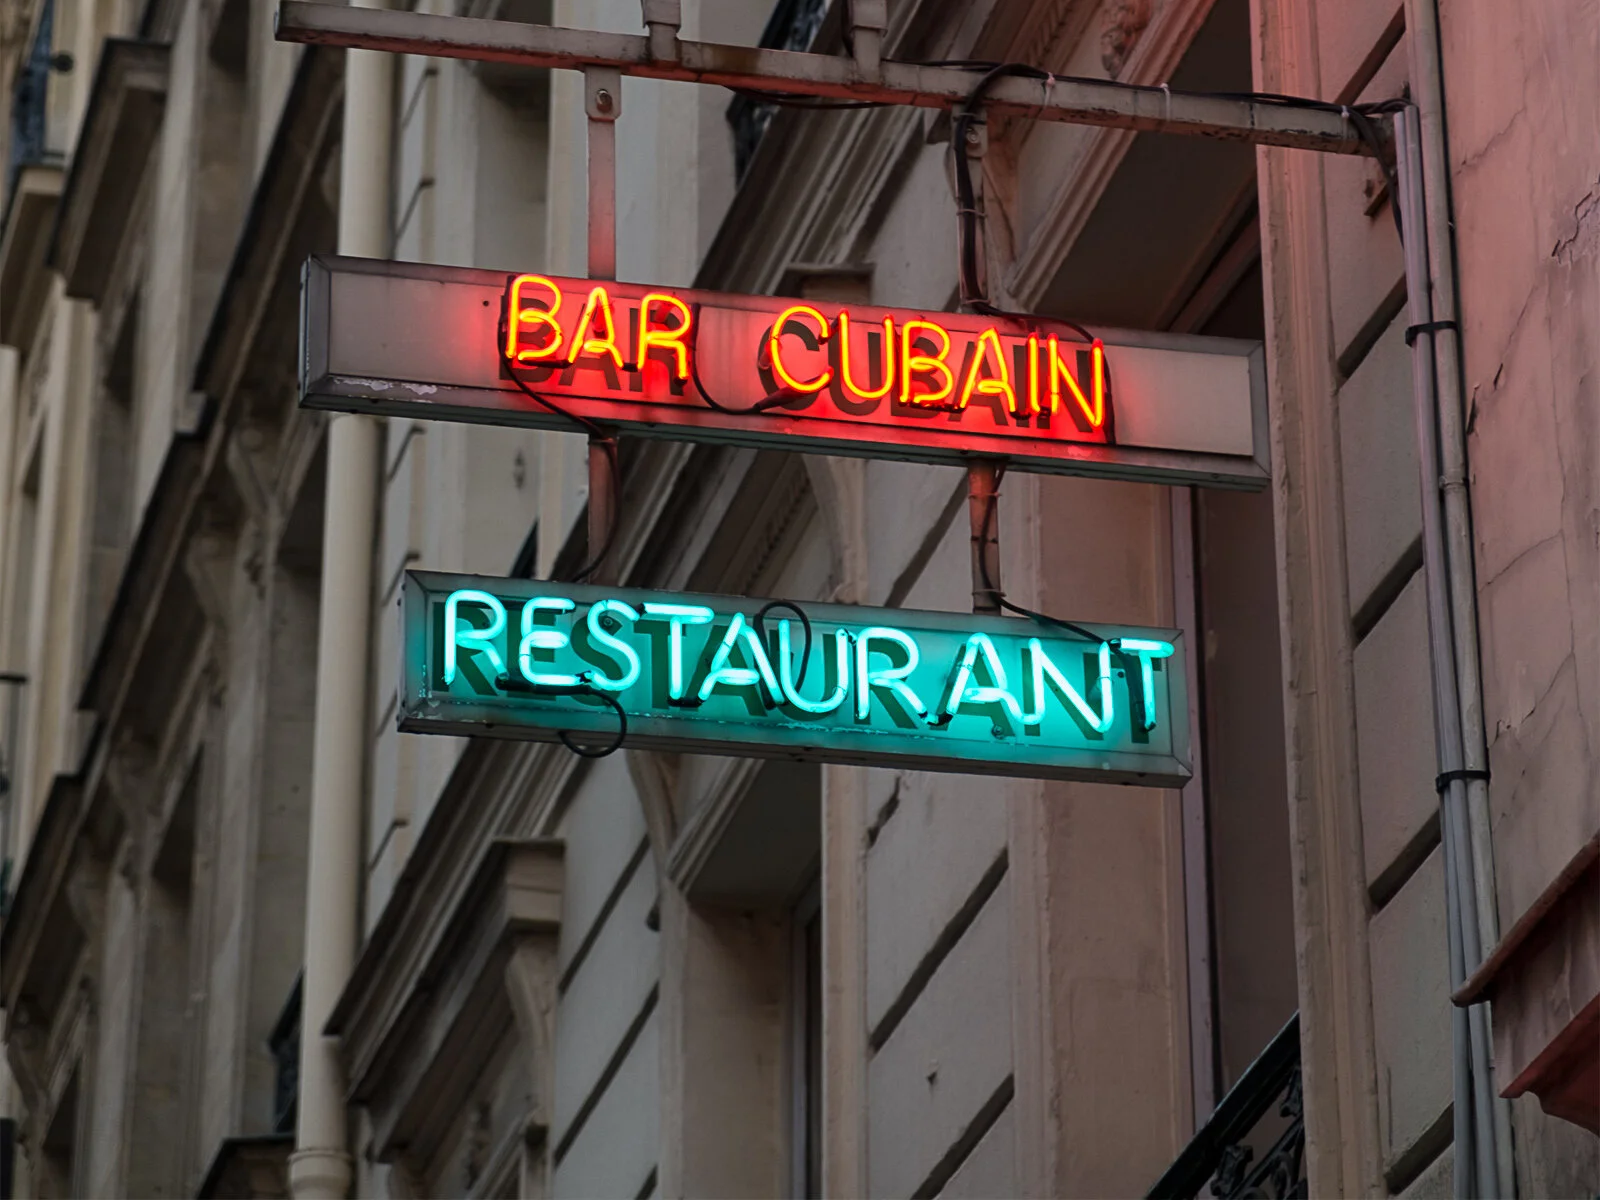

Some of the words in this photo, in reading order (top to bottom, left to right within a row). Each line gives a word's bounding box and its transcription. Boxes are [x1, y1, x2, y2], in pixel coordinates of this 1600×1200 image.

[504, 273, 694, 383] BAR
[768, 304, 1104, 428] CUBAIN
[442, 589, 1176, 732] RESTAURANT
